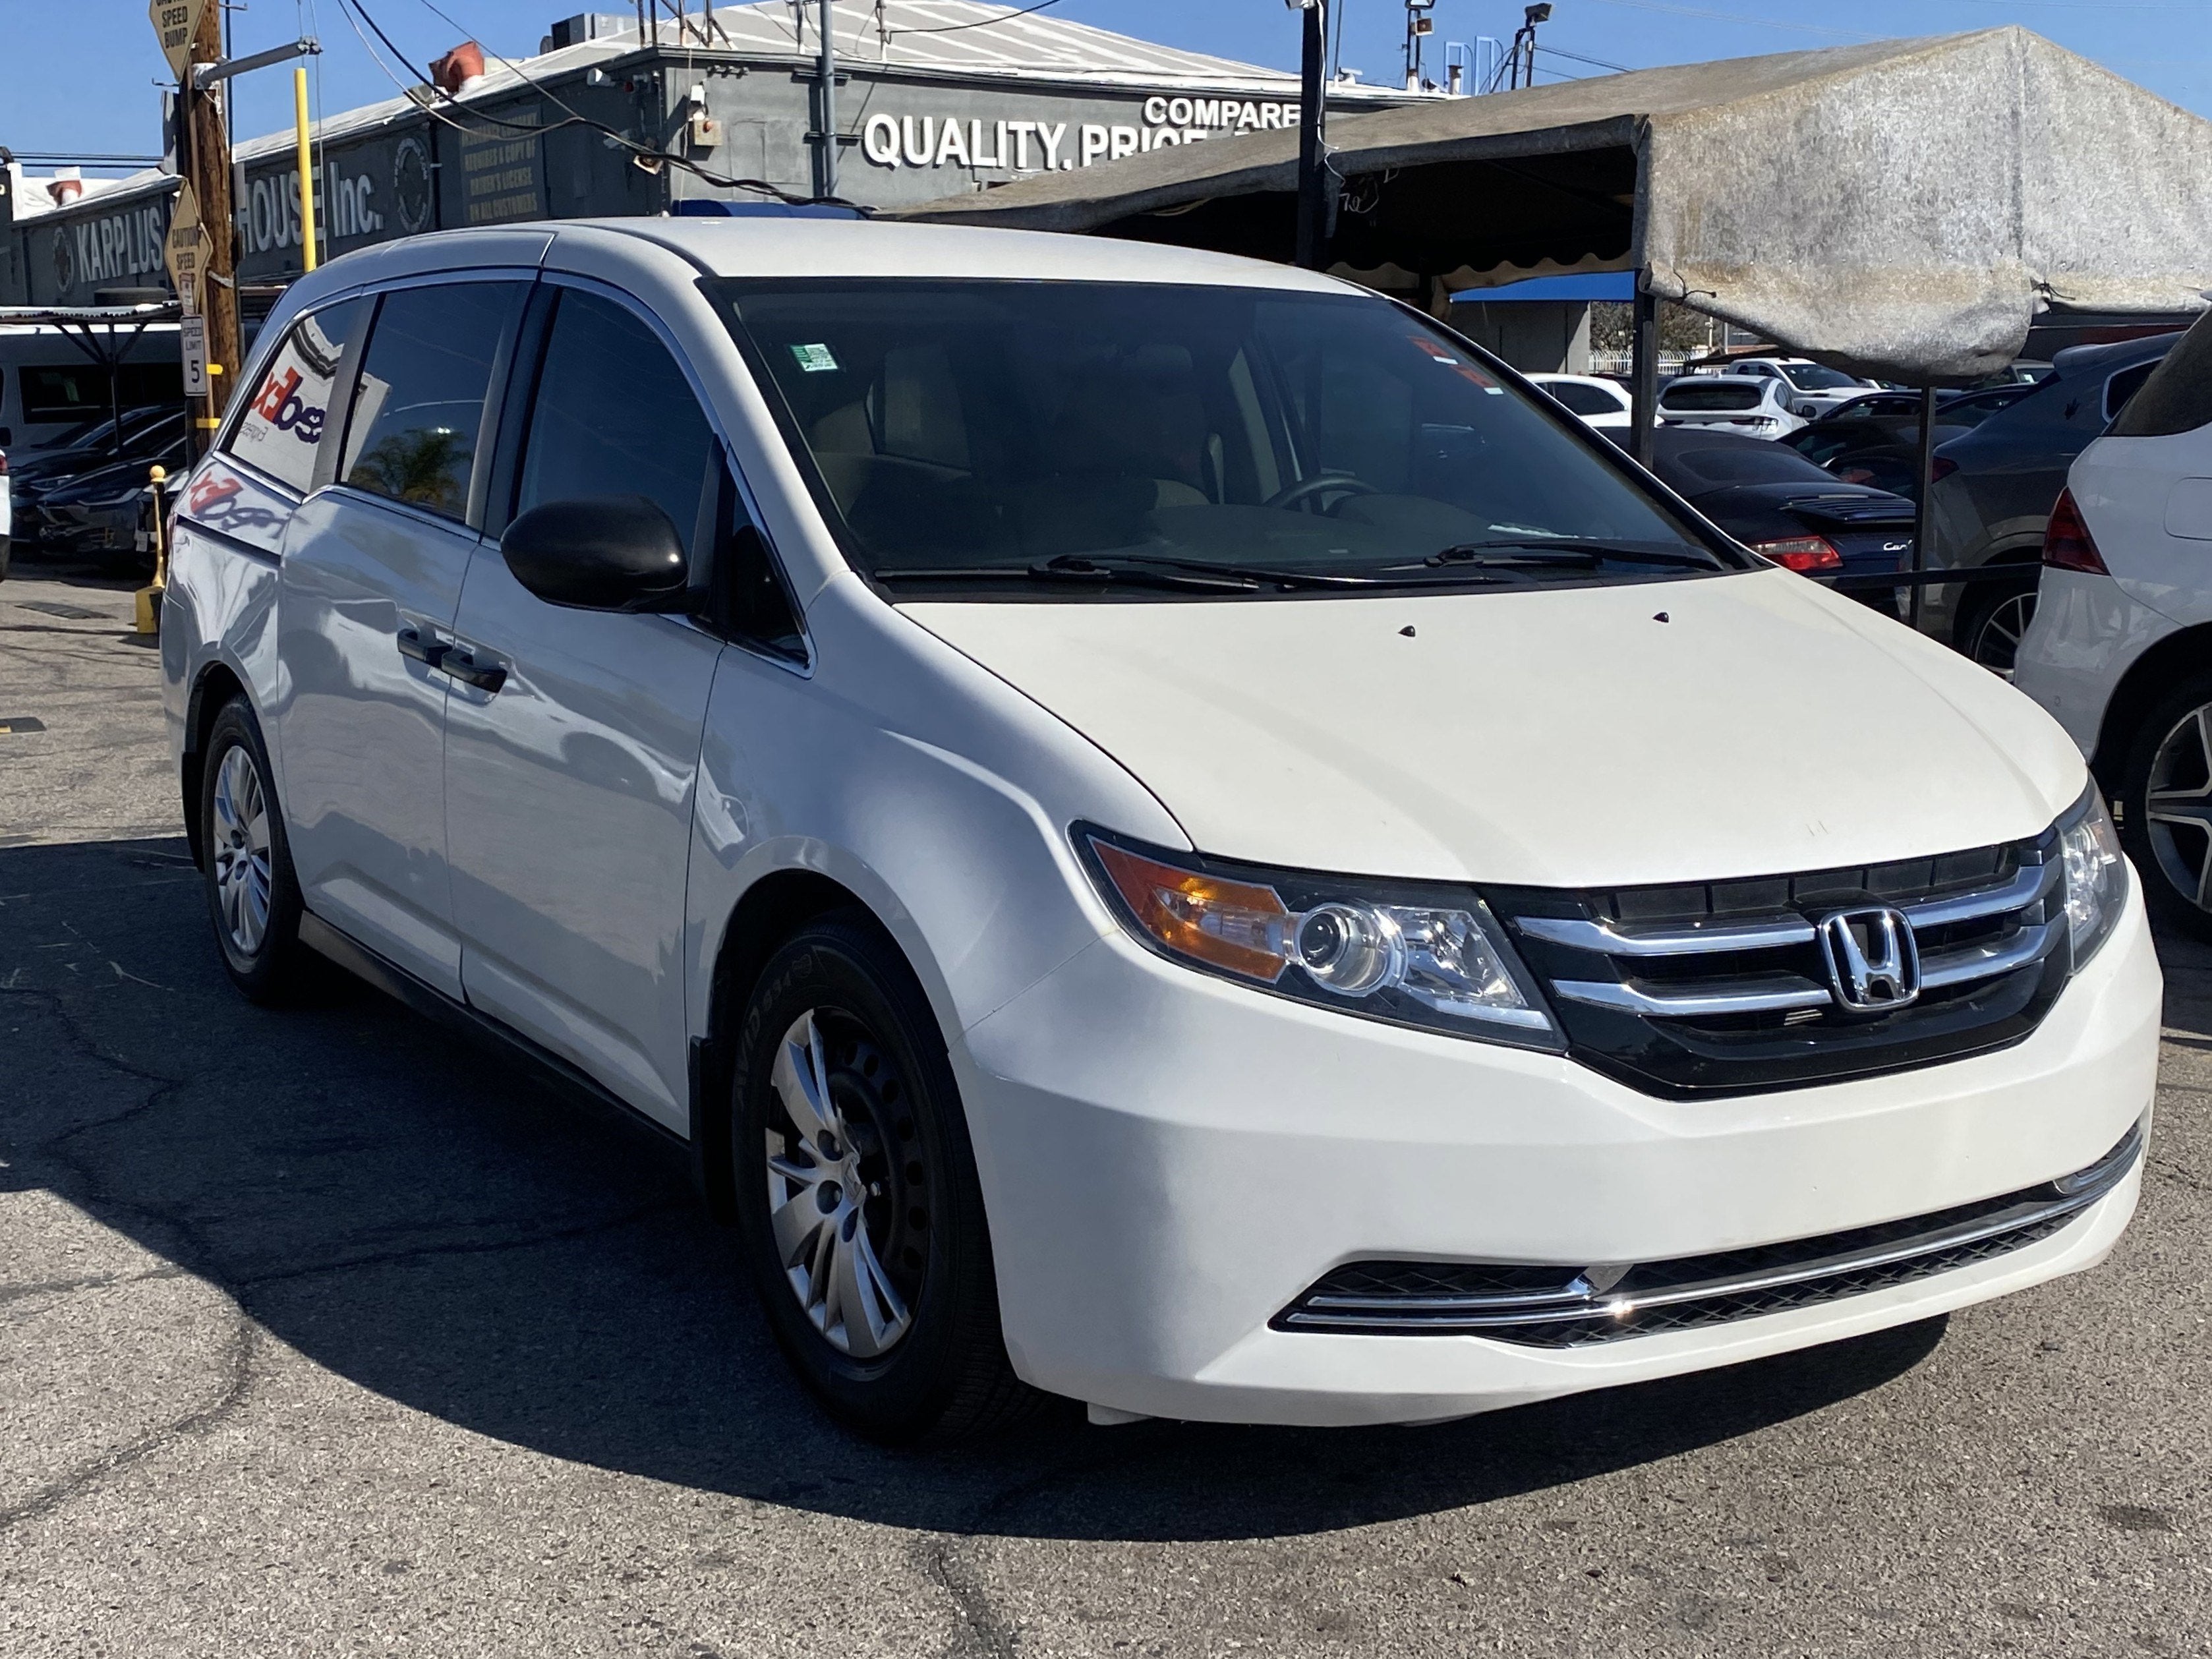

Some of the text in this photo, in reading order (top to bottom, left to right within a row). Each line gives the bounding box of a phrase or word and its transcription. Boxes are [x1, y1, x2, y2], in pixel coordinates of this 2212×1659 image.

[161, 6, 187, 28] SPEED
[165, 28, 187, 48] BUMP
[1145, 96, 1301, 129] COMPARE
[76, 206, 163, 283] KARPLUS
[330, 161, 383, 237] Inc.
[176, 252, 196, 271] SPEED
[183, 326, 202, 337] SPEED
[185, 340, 202, 351] LIMIT
[190, 359, 200, 384] 5
